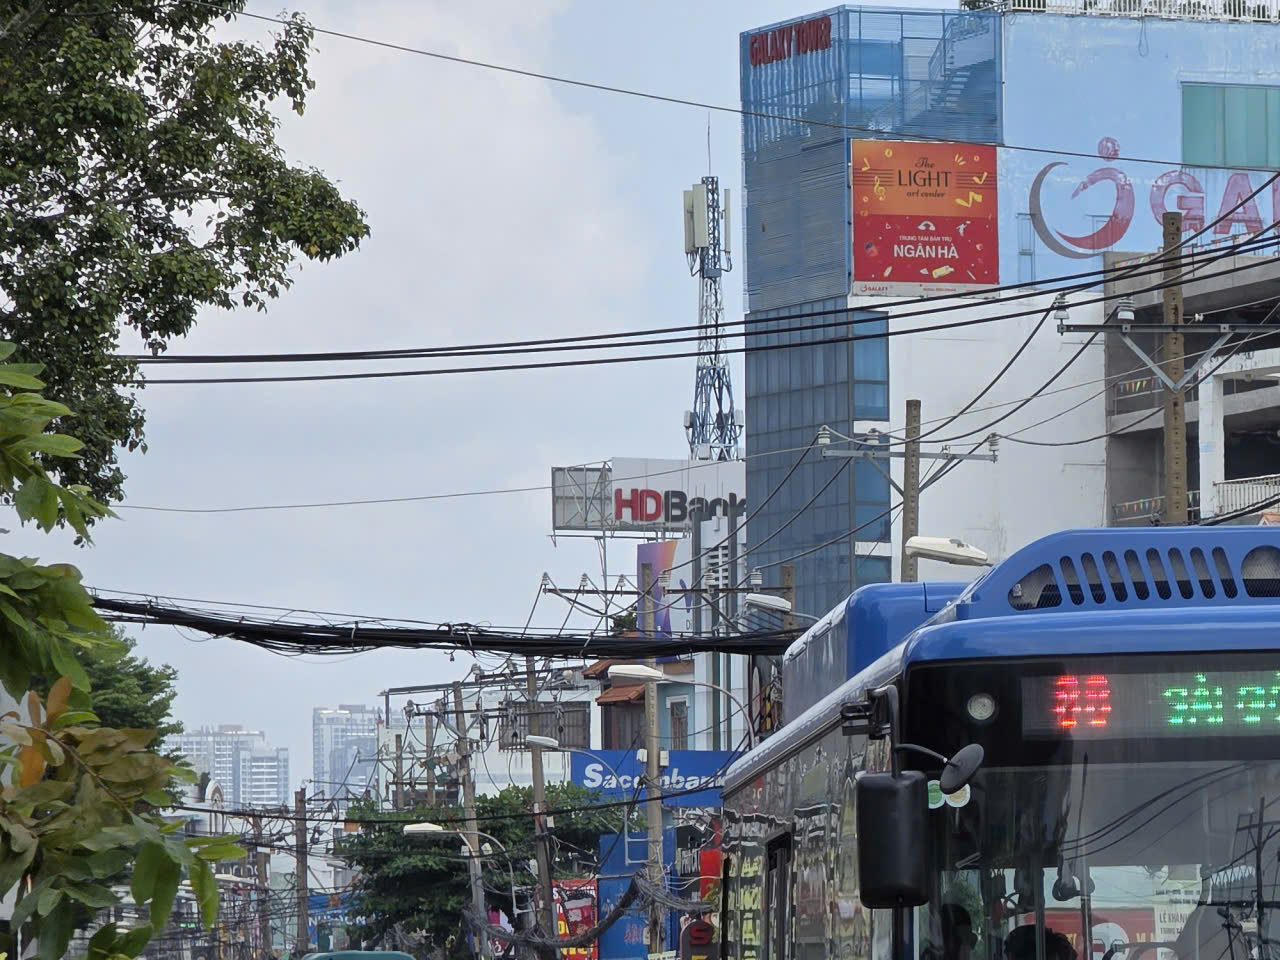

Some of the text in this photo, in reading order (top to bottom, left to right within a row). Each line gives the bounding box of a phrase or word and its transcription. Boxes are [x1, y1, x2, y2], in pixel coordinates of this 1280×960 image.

[898, 170, 952, 187] LIGHT
[893, 243, 959, 259] NGÂN HÀ
[615, 488, 746, 523] HDBank
